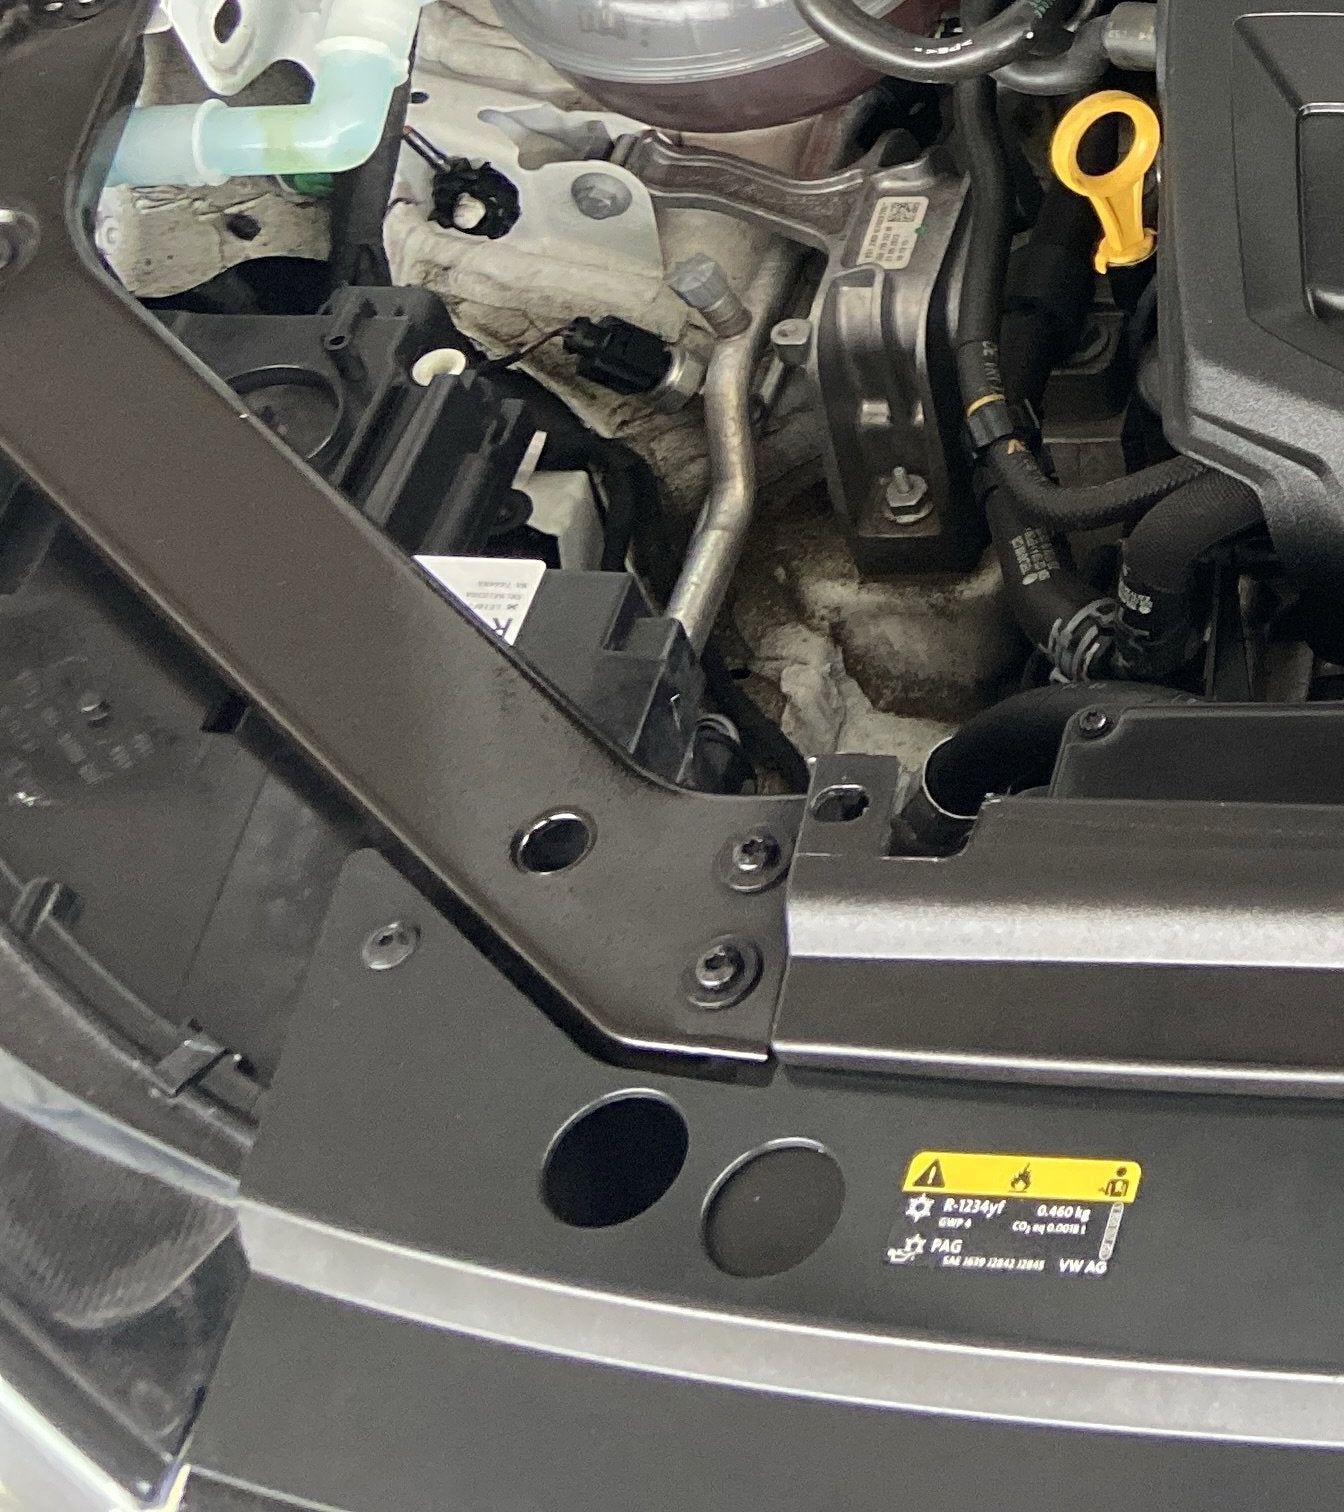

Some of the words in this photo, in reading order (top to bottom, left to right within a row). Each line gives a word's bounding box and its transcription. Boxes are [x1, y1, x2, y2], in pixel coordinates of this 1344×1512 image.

[943, 1197, 1007, 1219] R-1234yf
[1037, 1204, 1073, 1218] 0.460
[1074, 1206, 1091, 1223] kg
[930, 1238, 963, 1254] PAG
[1059, 1258, 1084, 1274] VW
[1084, 1260, 1108, 1275] AG
